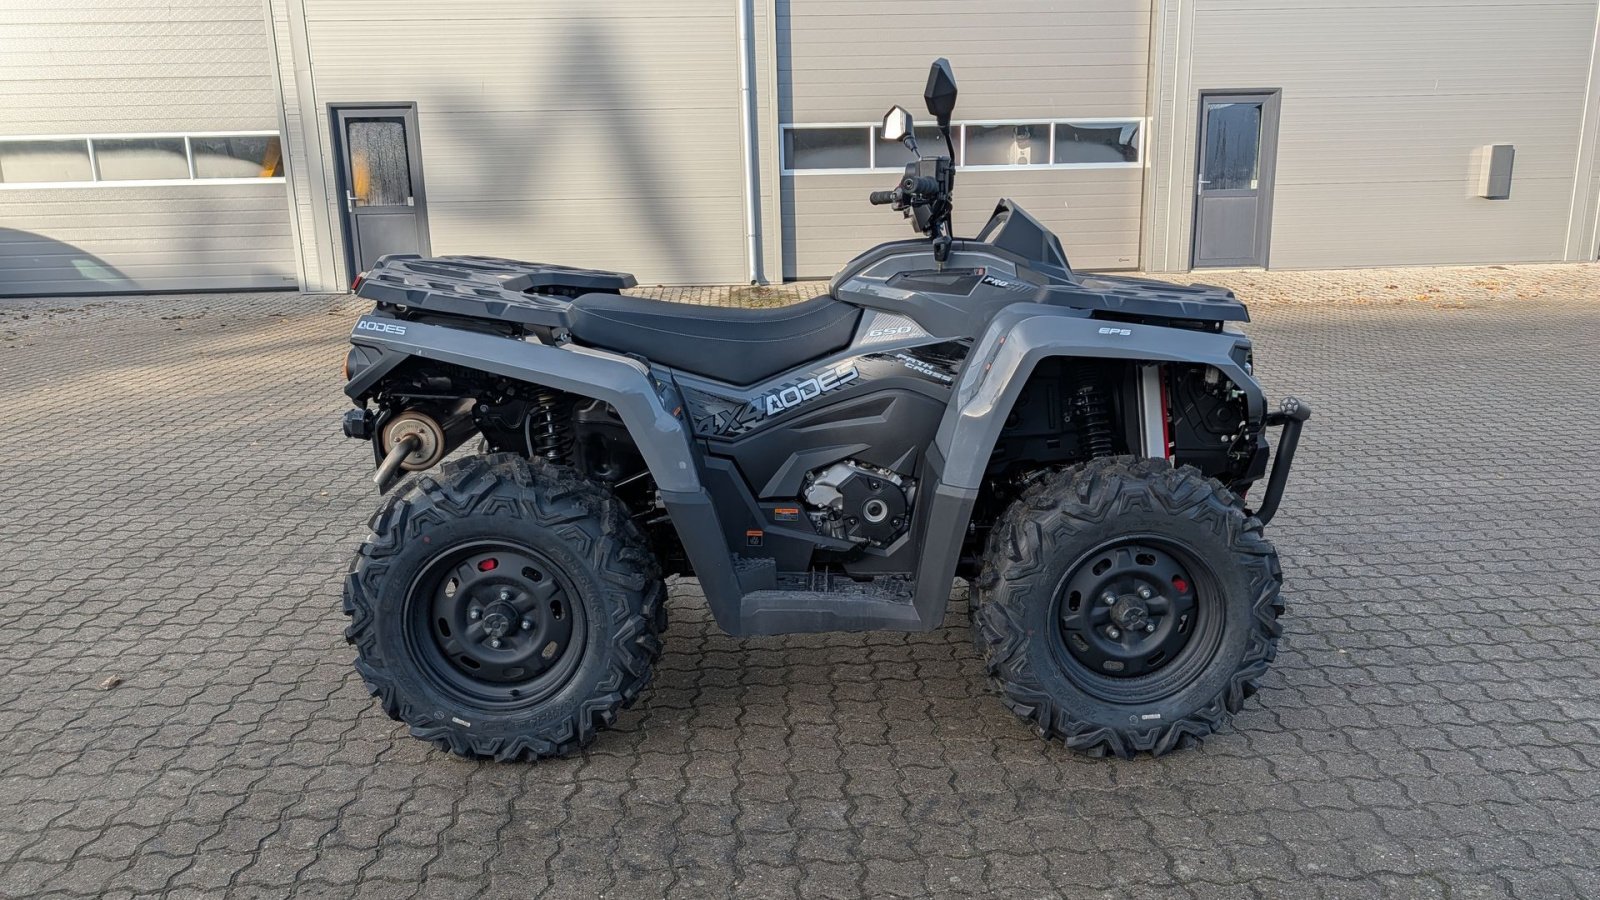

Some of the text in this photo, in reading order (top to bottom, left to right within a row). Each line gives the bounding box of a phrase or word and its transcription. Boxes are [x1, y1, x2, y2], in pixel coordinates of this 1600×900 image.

[984, 276, 1009, 287] PRO
[357, 320, 407, 336] AODES
[870, 326, 912, 337] 650
[1098, 327, 1132, 336] EPS
[896, 353, 934, 370] PATH
[904, 362, 953, 382] CROSS
[766, 360, 859, 416] AODES
